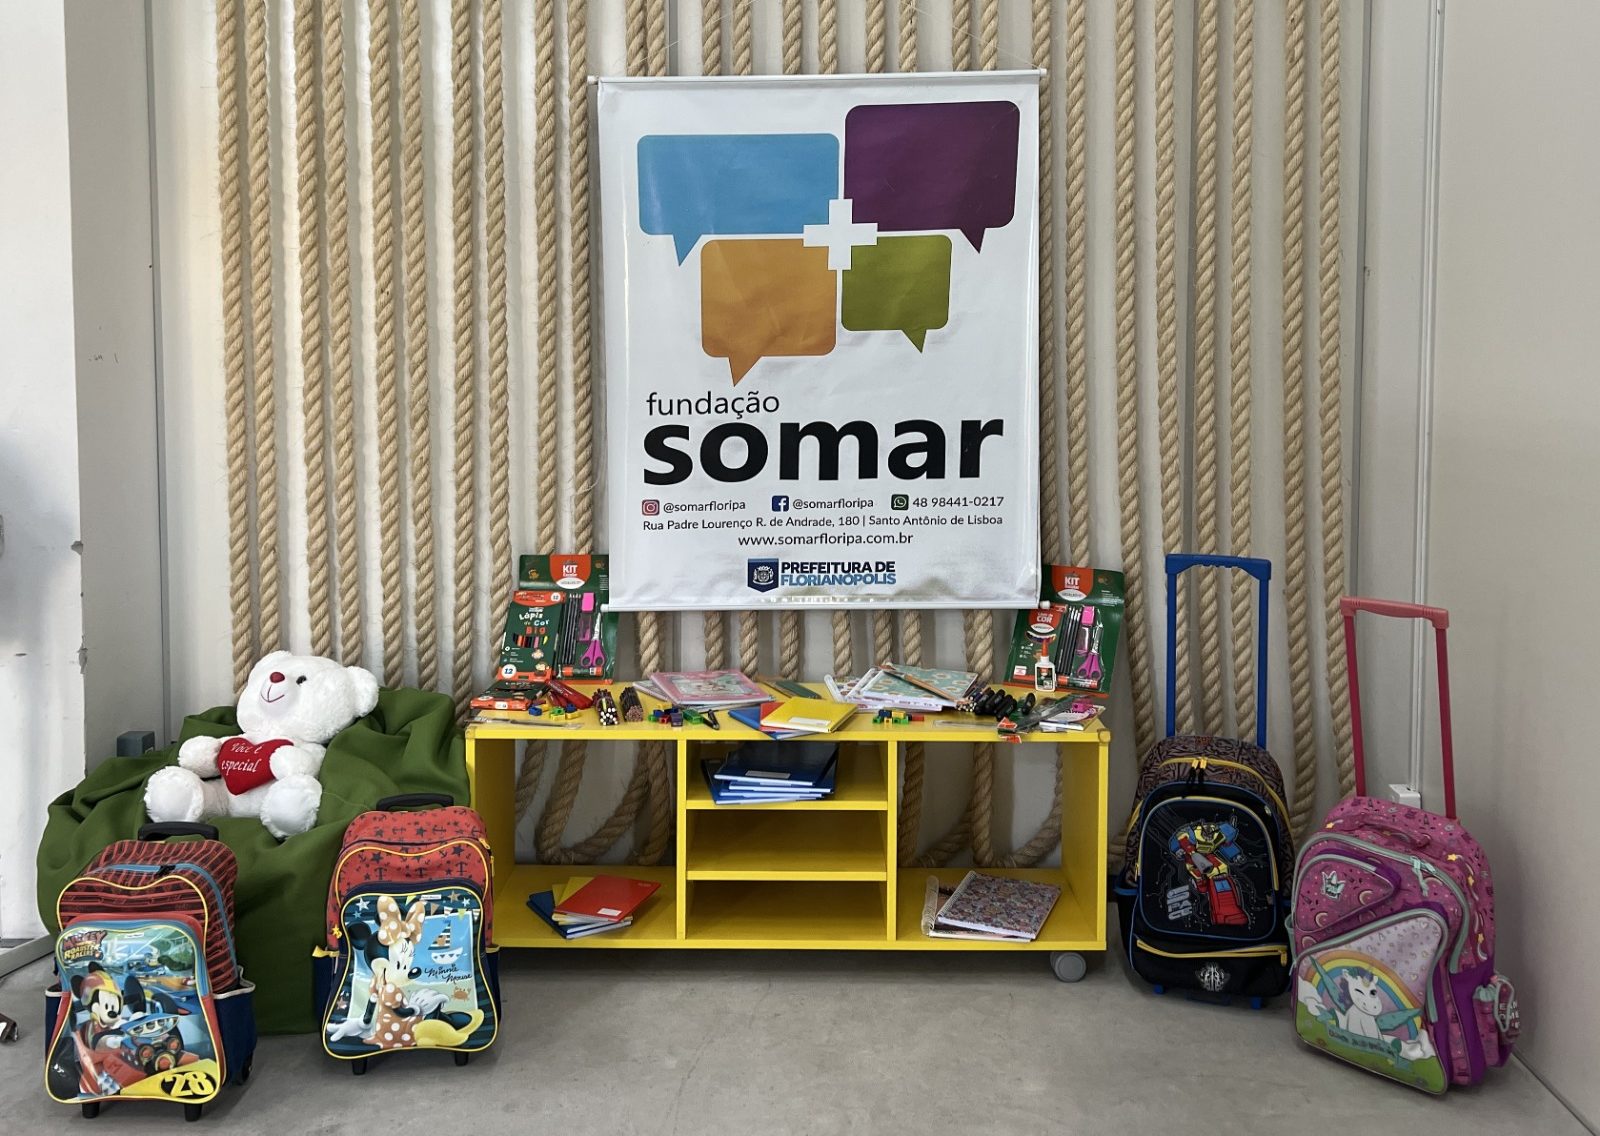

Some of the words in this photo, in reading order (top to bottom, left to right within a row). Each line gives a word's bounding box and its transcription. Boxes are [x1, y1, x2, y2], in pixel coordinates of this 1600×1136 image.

[646, 391, 780, 419] fundação
[643, 419, 1004, 486] somar
[663, 500, 746, 514] @somarfloripa
[792, 498, 874, 511] @somarfloripa
[912, 497, 928, 507] 48
[931, 496, 1005, 507] 98441-0217
[643, 520, 664, 531] Rua
[667, 519, 699, 530] Padre
[702, 519, 753, 530] Lourenço
[756, 517, 767, 527] R.
[769, 516, 783, 527] de
[785, 516, 835, 528] Andrade,
[838, 516, 860, 526] 180
[868, 515, 901, 526] Santo
[903, 515, 947, 526] Antônio
[950, 514, 964, 525] de
[967, 514, 1003, 525] Lisboa
[738, 532, 914, 546] www.somarfloripa.com.br
[562, 564, 578, 574] KIT
[781, 561, 872, 574] PREFEITURA
[874, 561, 896, 573] DE
[1064, 576, 1080, 586] KIT
[518, 612, 543, 620] Lápis
[1036, 615, 1053, 623] COR
[533, 619, 550, 627] Cor
[221, 758, 262, 776] especial
[424, 963, 460, 977] Minnie
[441, 973, 473, 983] Mouse
[164, 1071, 214, 1097] 28
